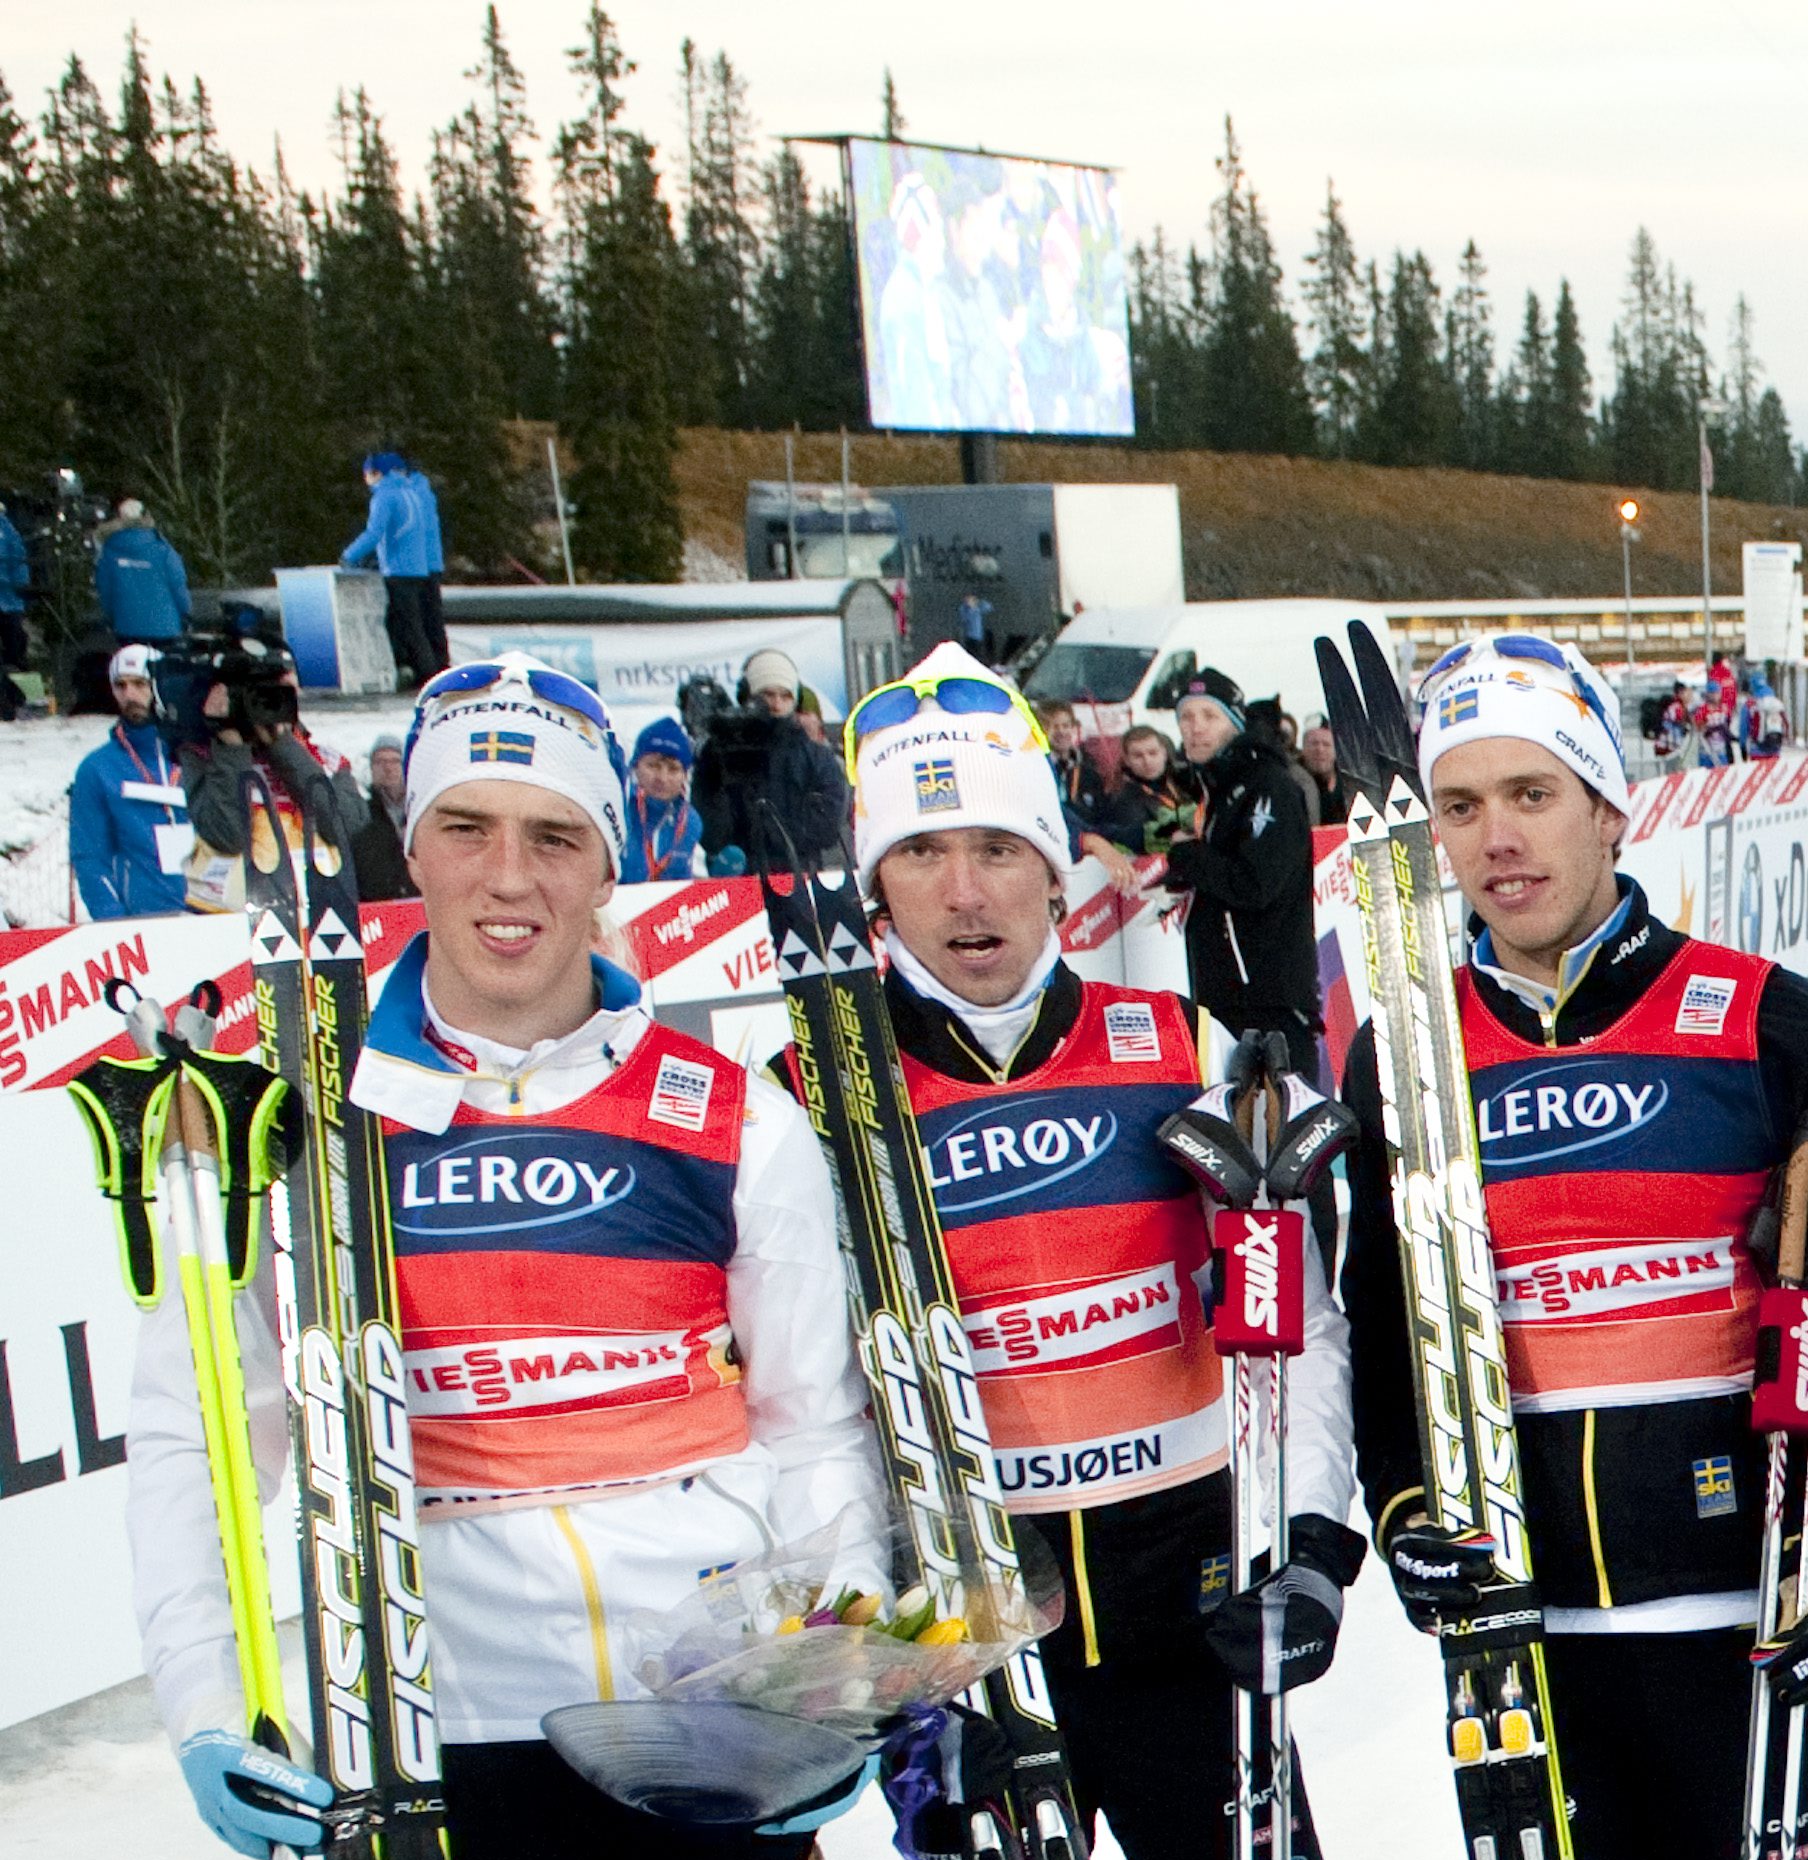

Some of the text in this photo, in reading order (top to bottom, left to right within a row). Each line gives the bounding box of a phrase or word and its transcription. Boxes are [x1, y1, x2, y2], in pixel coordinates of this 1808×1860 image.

[1355, 856, 1384, 995] FISCHER
[1392, 838, 1428, 981] FISCHER
[256, 978, 281, 1074] CHER
[313, 973, 345, 1128] FISCHER
[790, 994, 832, 1138] FISCHER
[834, 986, 883, 1131] FISCHER
[921, 1115, 1103, 1188] LERØY
[1477, 1081, 1655, 1143] LERØY
[402, 1156, 620, 1210] LERØY
[997, 1434, 1163, 1492] USJØEN
